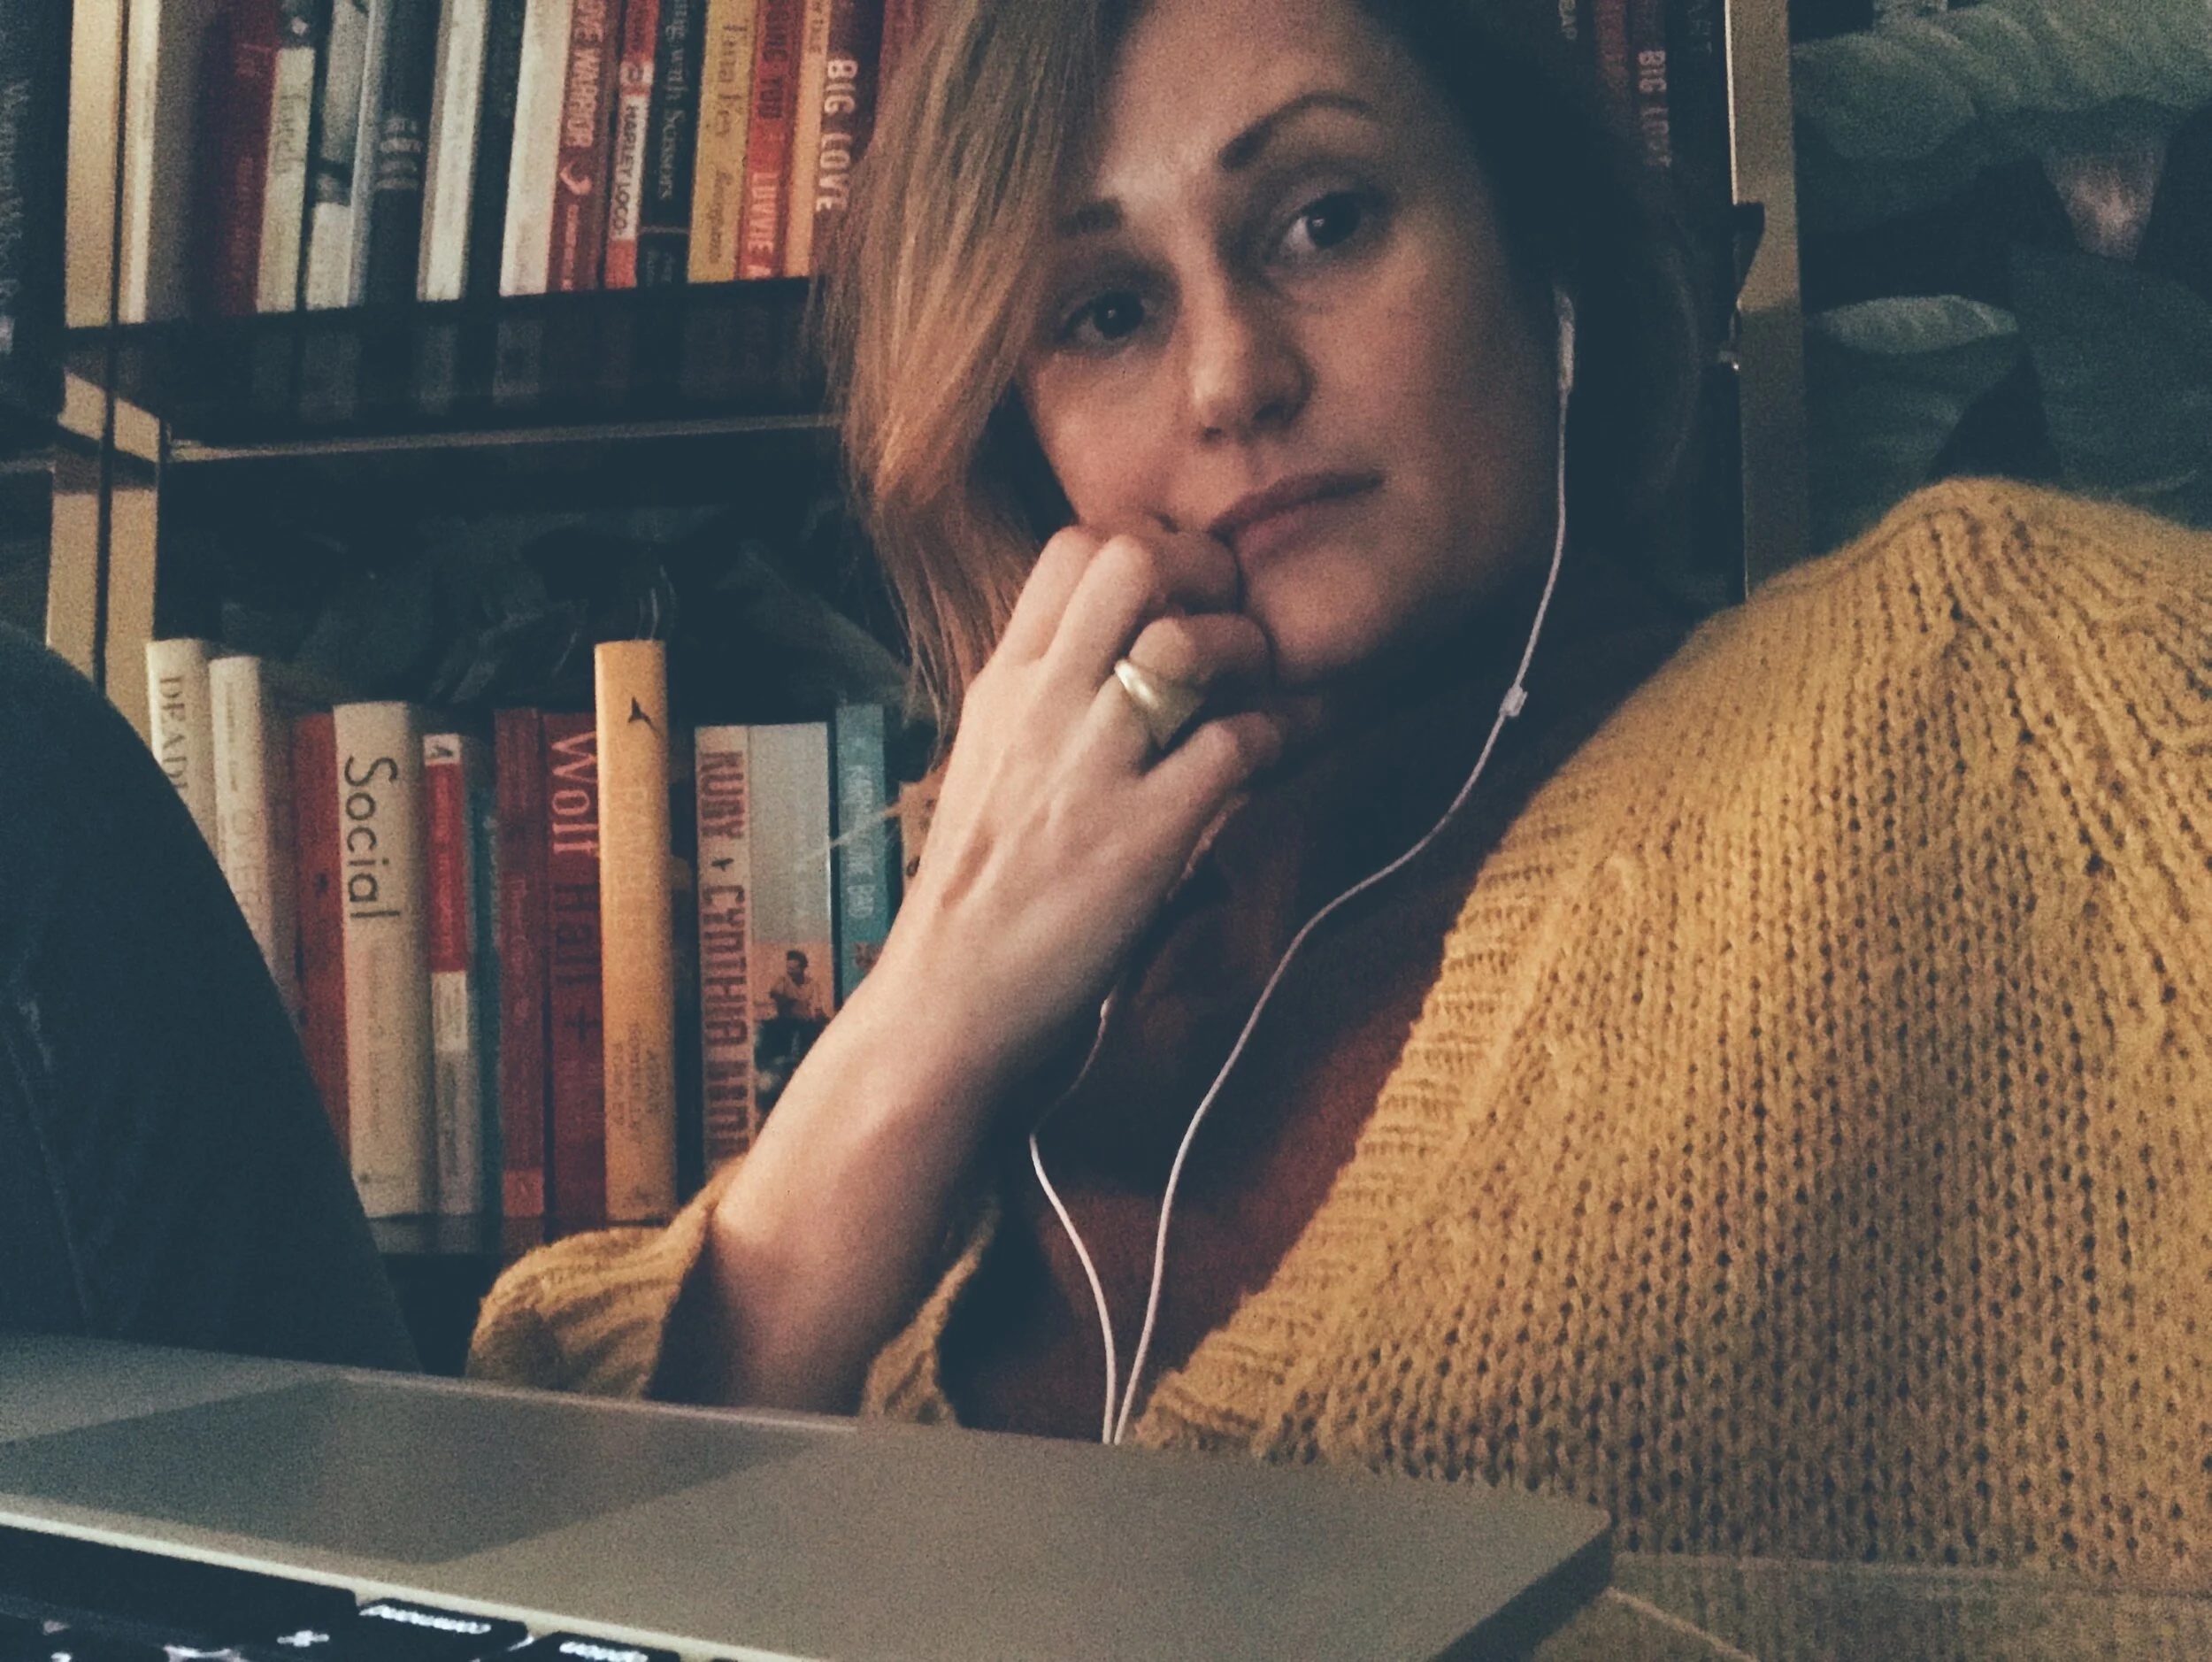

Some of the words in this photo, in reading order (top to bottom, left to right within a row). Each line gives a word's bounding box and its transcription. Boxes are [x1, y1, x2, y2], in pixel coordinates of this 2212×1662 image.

[665, 0, 690, 41] ing
[566, 47, 602, 147] WARRIOR
[664, 47, 690, 102] with
[823, 58, 859, 115] BIG
[1637, 50, 1668, 94] BIG
[618, 104, 640, 178] HARLEY
[657, 108, 687, 201] Scissors
[815, 132, 852, 212] LOVE
[748, 172, 780, 254] LUVVIE
[550, 731, 598, 858] Wolf
[700, 751, 745, 842] RUBY
[344, 756, 401, 920] Social
[702, 884, 749, 1046] CYNTHIA
